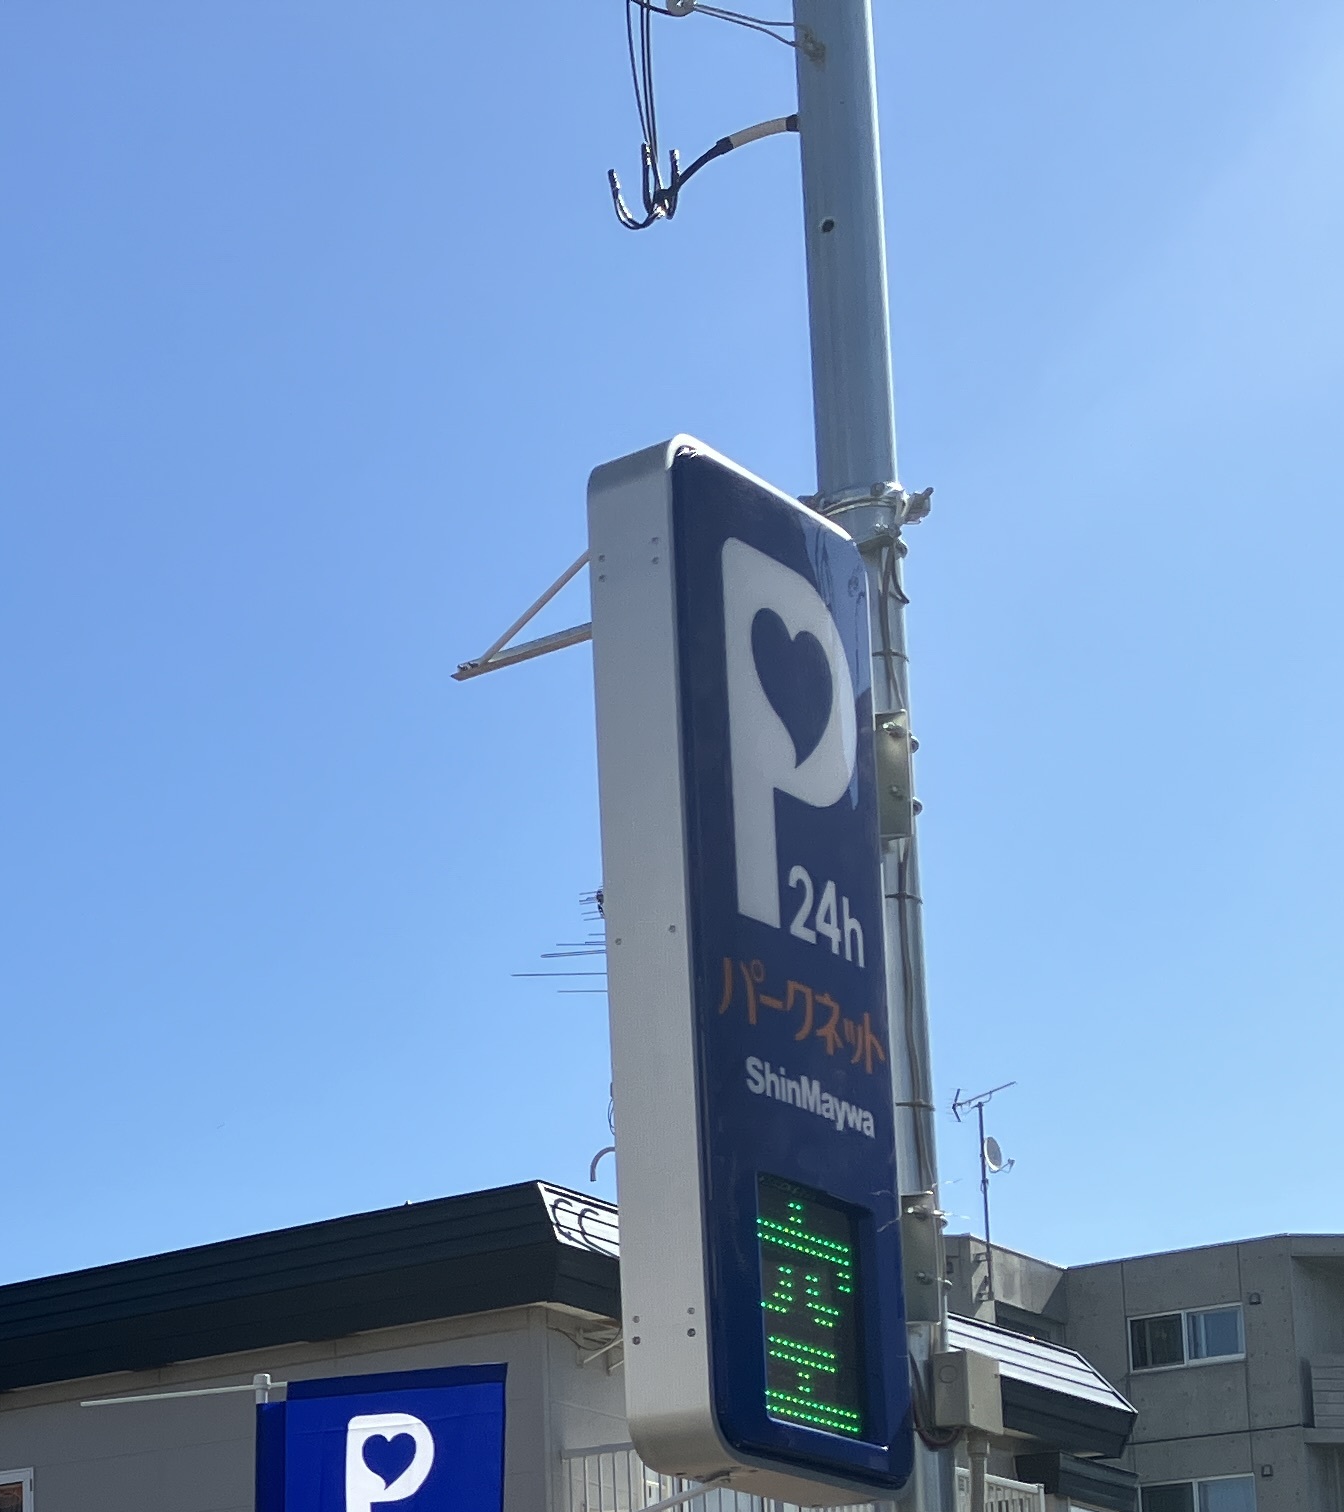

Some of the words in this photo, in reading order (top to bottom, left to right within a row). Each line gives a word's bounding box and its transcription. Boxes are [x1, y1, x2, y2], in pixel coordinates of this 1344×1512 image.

[721, 536, 858, 929] P
[788, 864, 865, 968] 24h
[718, 957, 886, 1075] パークネット
[745, 1055, 875, 1139] ShinMaywa
